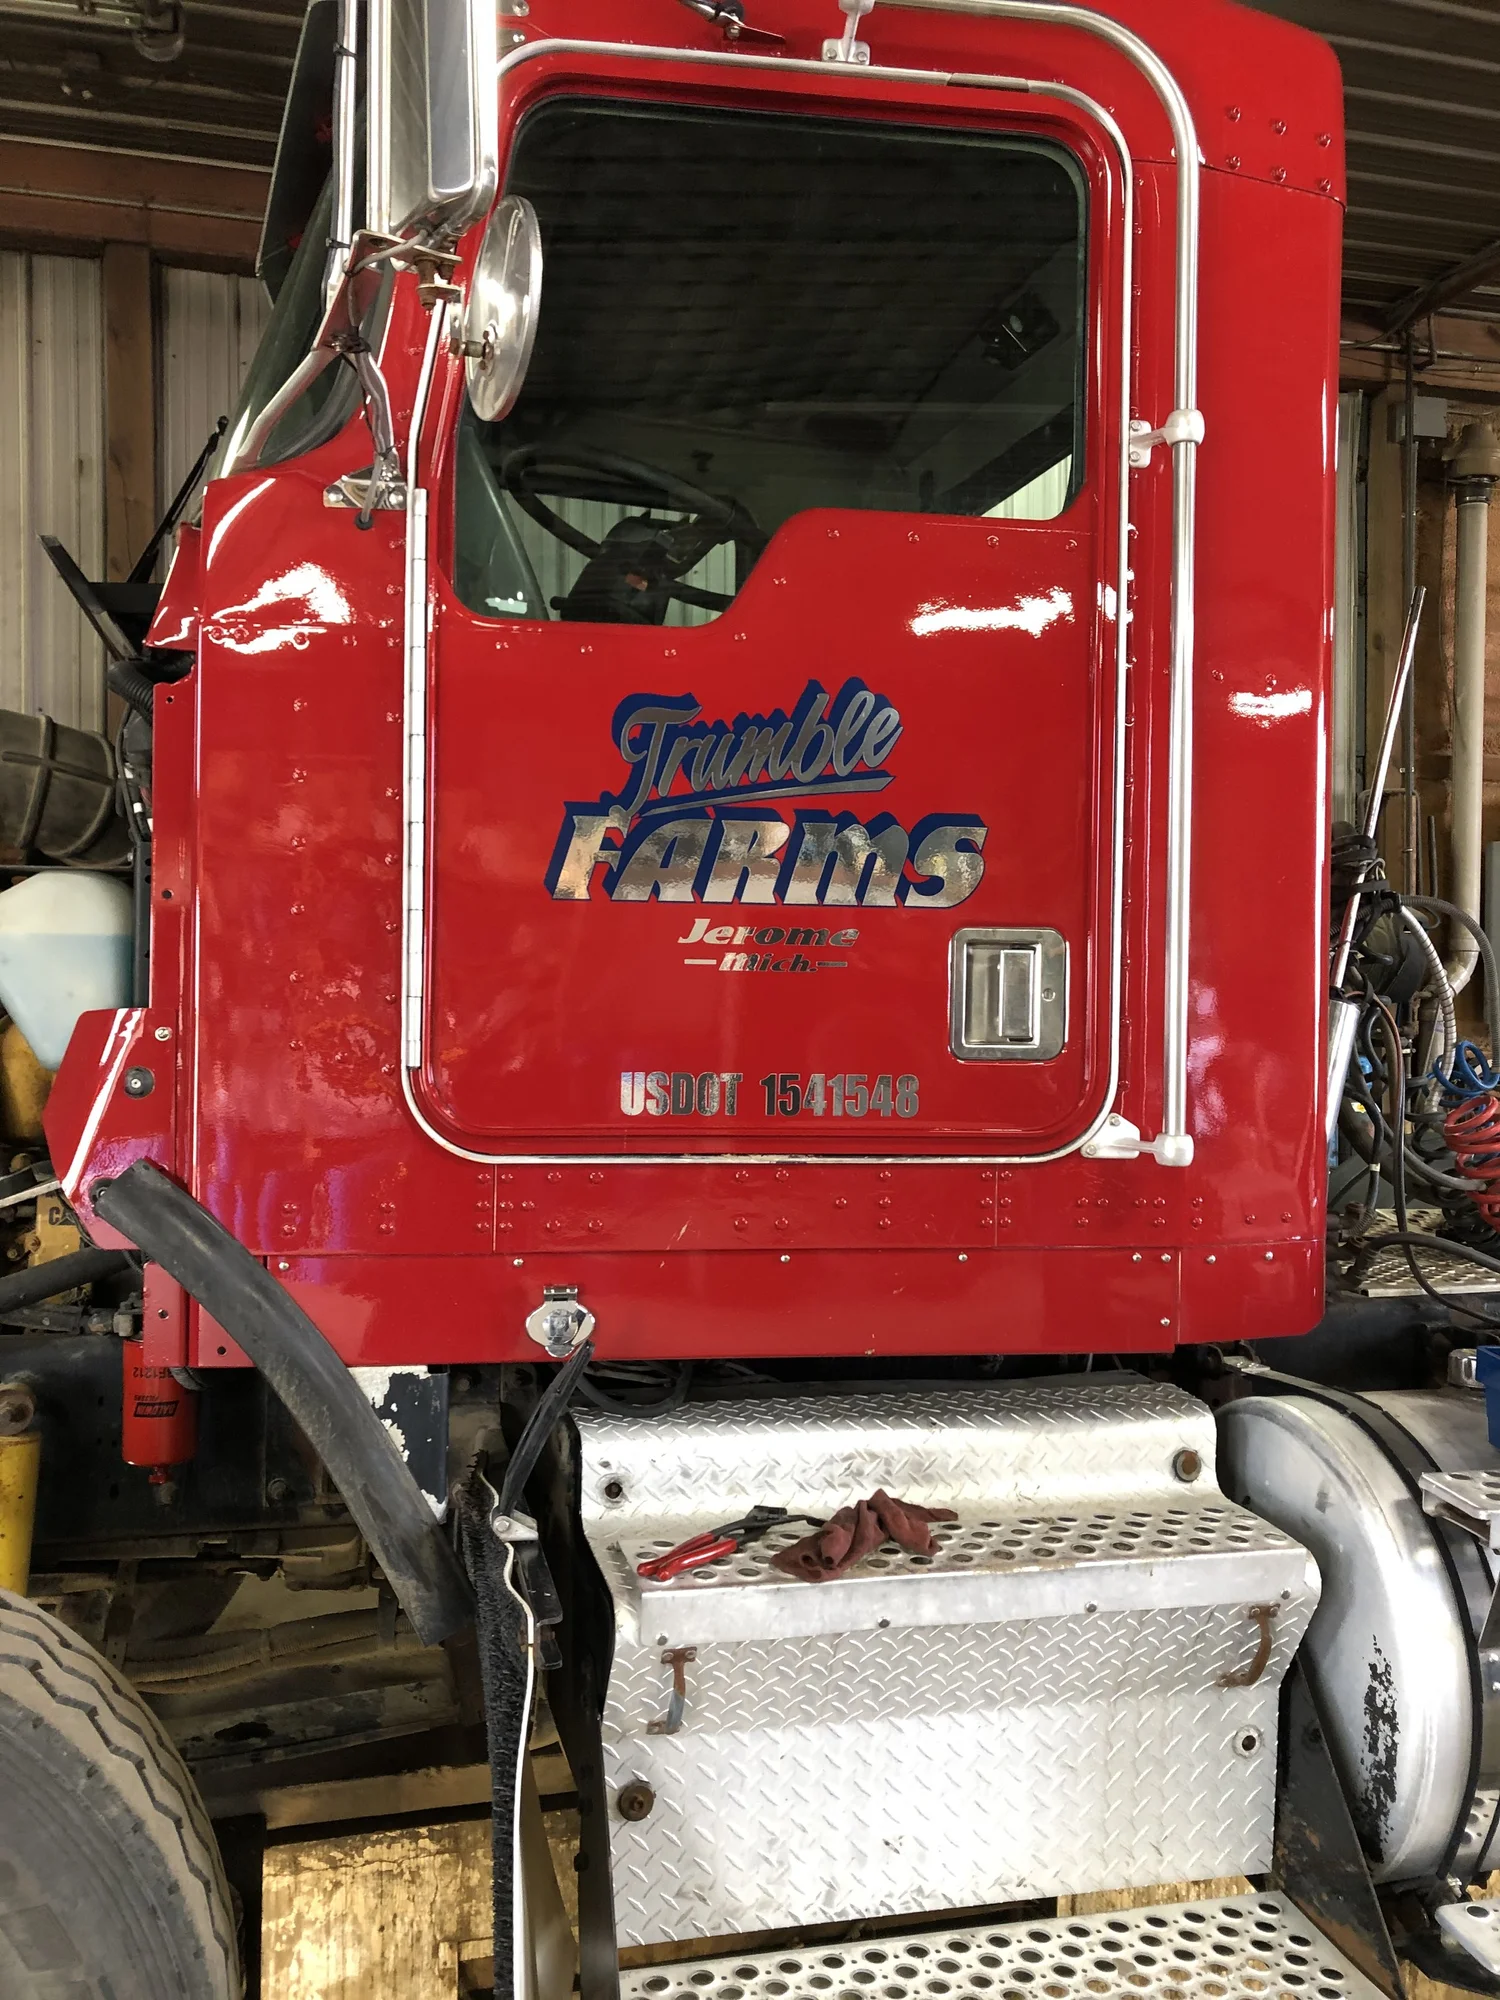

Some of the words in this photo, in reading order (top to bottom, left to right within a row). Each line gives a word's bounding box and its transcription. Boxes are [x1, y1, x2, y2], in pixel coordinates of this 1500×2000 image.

[611, 677, 904, 820] Trumble
[544, 800, 990, 909] FARMS
[677, 918, 860, 947] Jerome
[619, 1071, 744, 1116] USDOT
[759, 1073, 920, 1119] 1541548
